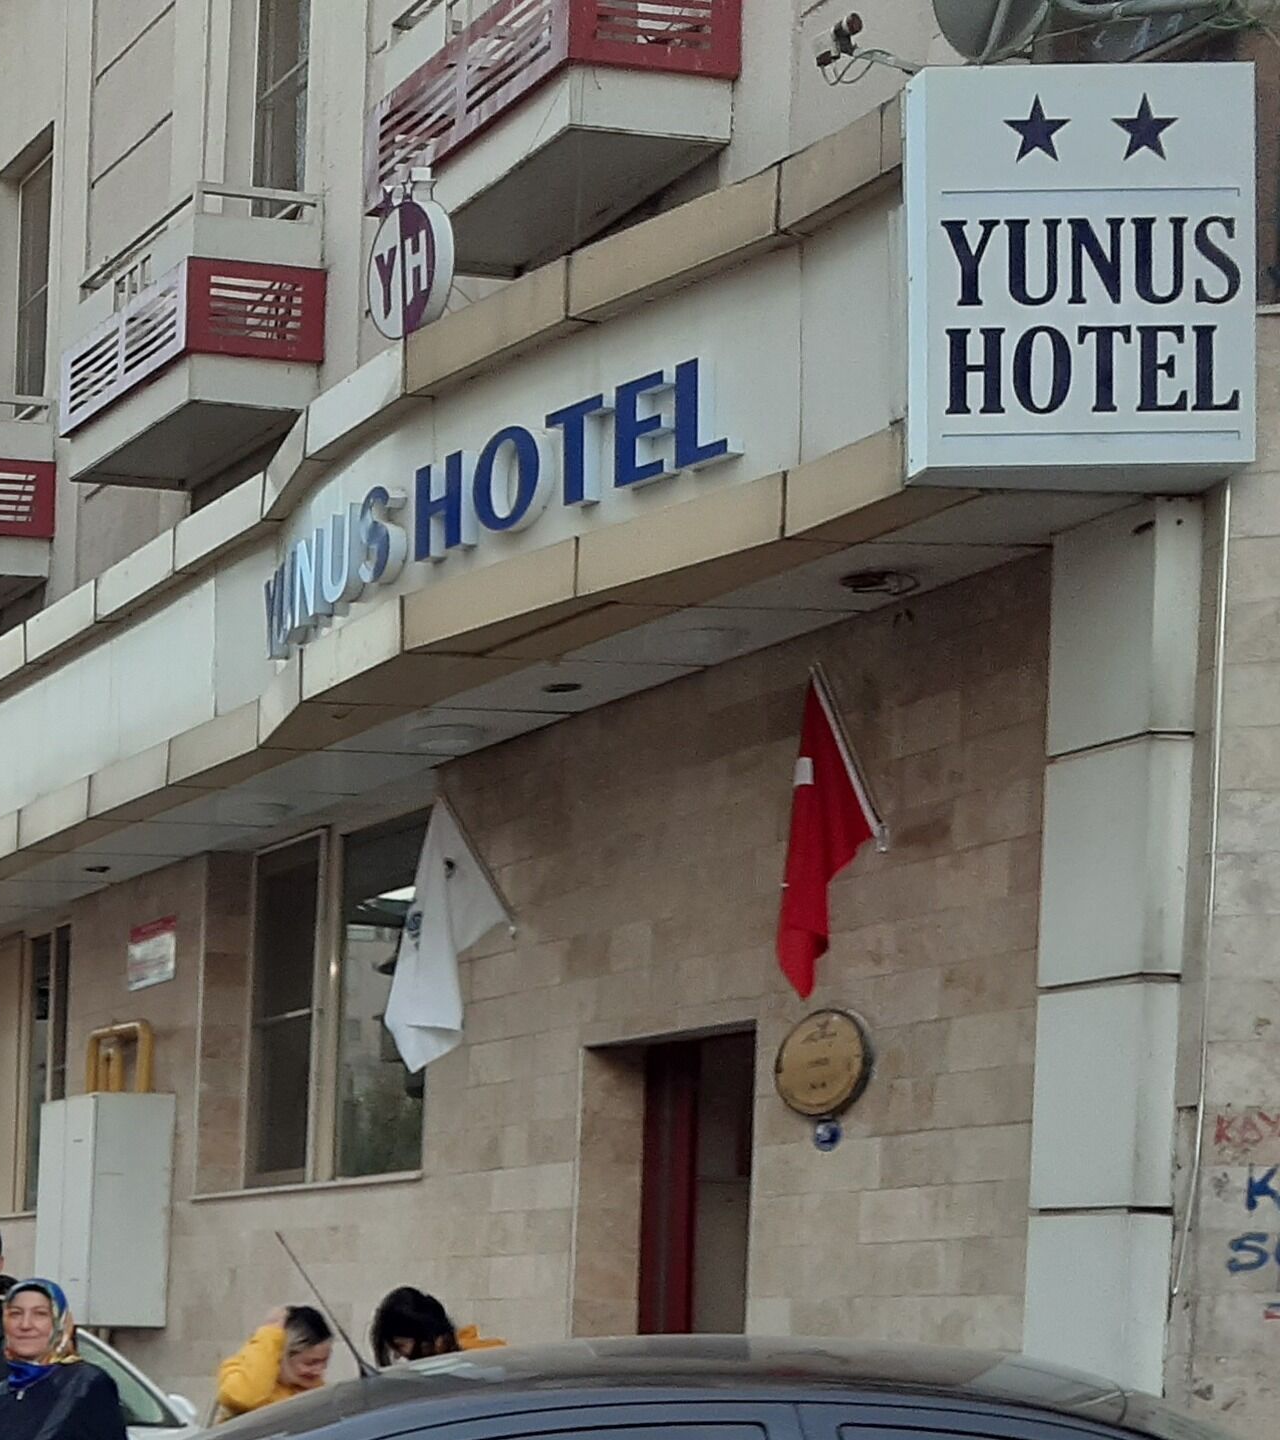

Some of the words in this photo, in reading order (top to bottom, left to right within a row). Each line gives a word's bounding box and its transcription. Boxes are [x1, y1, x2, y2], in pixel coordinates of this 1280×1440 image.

[940, 215, 1241, 307] YUNUS
[944, 324, 1240, 415] HOTEL
[263, 485, 406, 661] YUNUS
[415, 357, 738, 563] HOTEL
